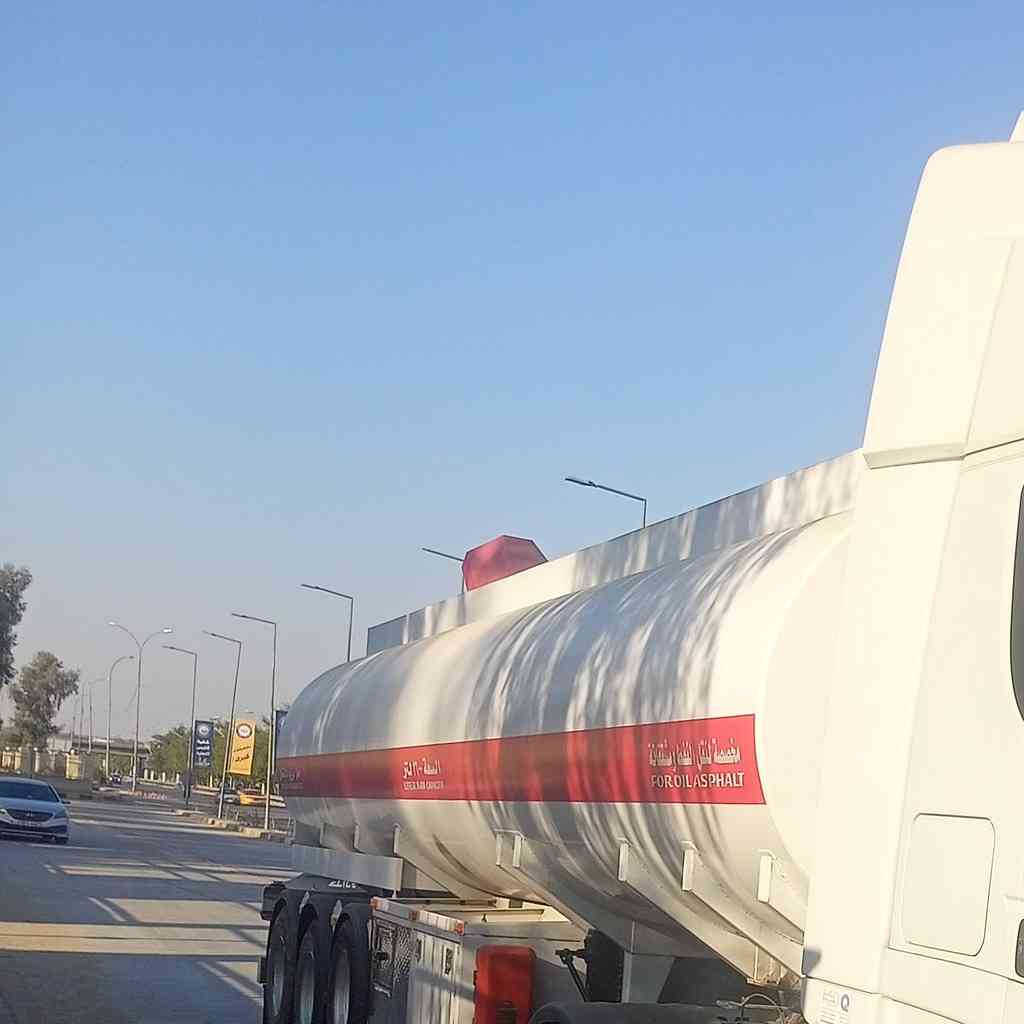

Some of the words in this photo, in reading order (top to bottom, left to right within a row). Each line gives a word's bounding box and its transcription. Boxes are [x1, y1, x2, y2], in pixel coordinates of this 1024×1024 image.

[651, 774, 673, 788] FOR
[673, 774, 692, 788] OIL
[693, 772, 745, 788] ASPHALT
